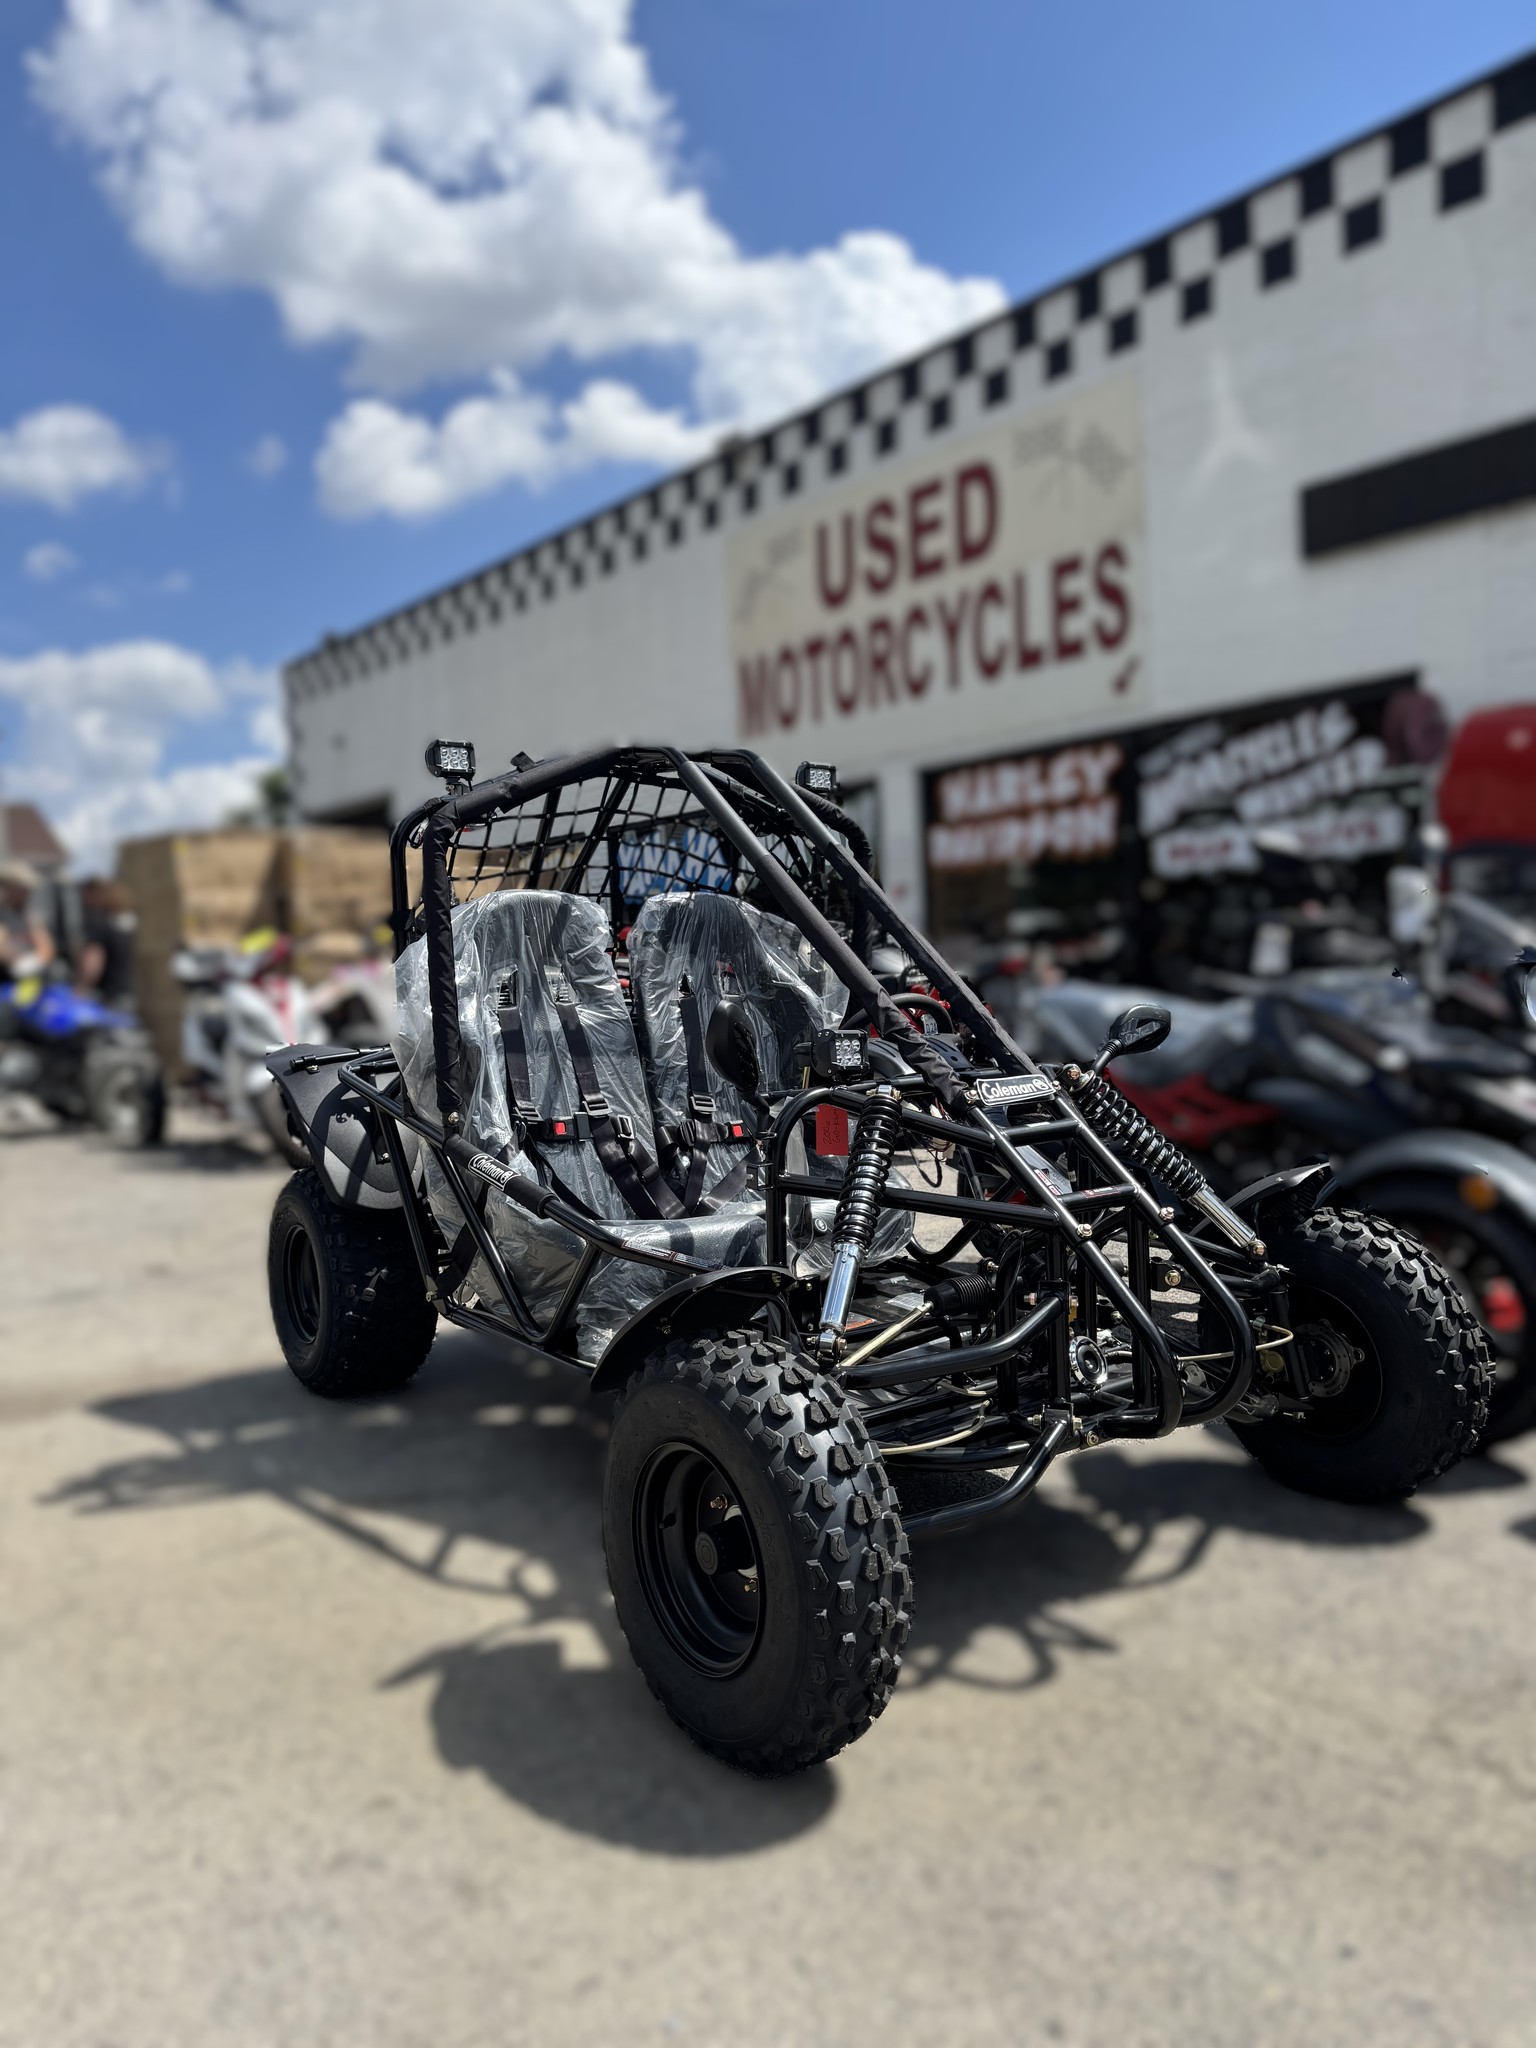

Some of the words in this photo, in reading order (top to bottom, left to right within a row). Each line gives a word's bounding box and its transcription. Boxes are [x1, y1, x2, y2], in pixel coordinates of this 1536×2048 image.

[817, 460, 1000, 613] USED
[737, 539, 1132, 740] MOTORCYCLES
[981, 1082, 1037, 1099] Coleman
[472, 1155, 504, 1180] Coleman
